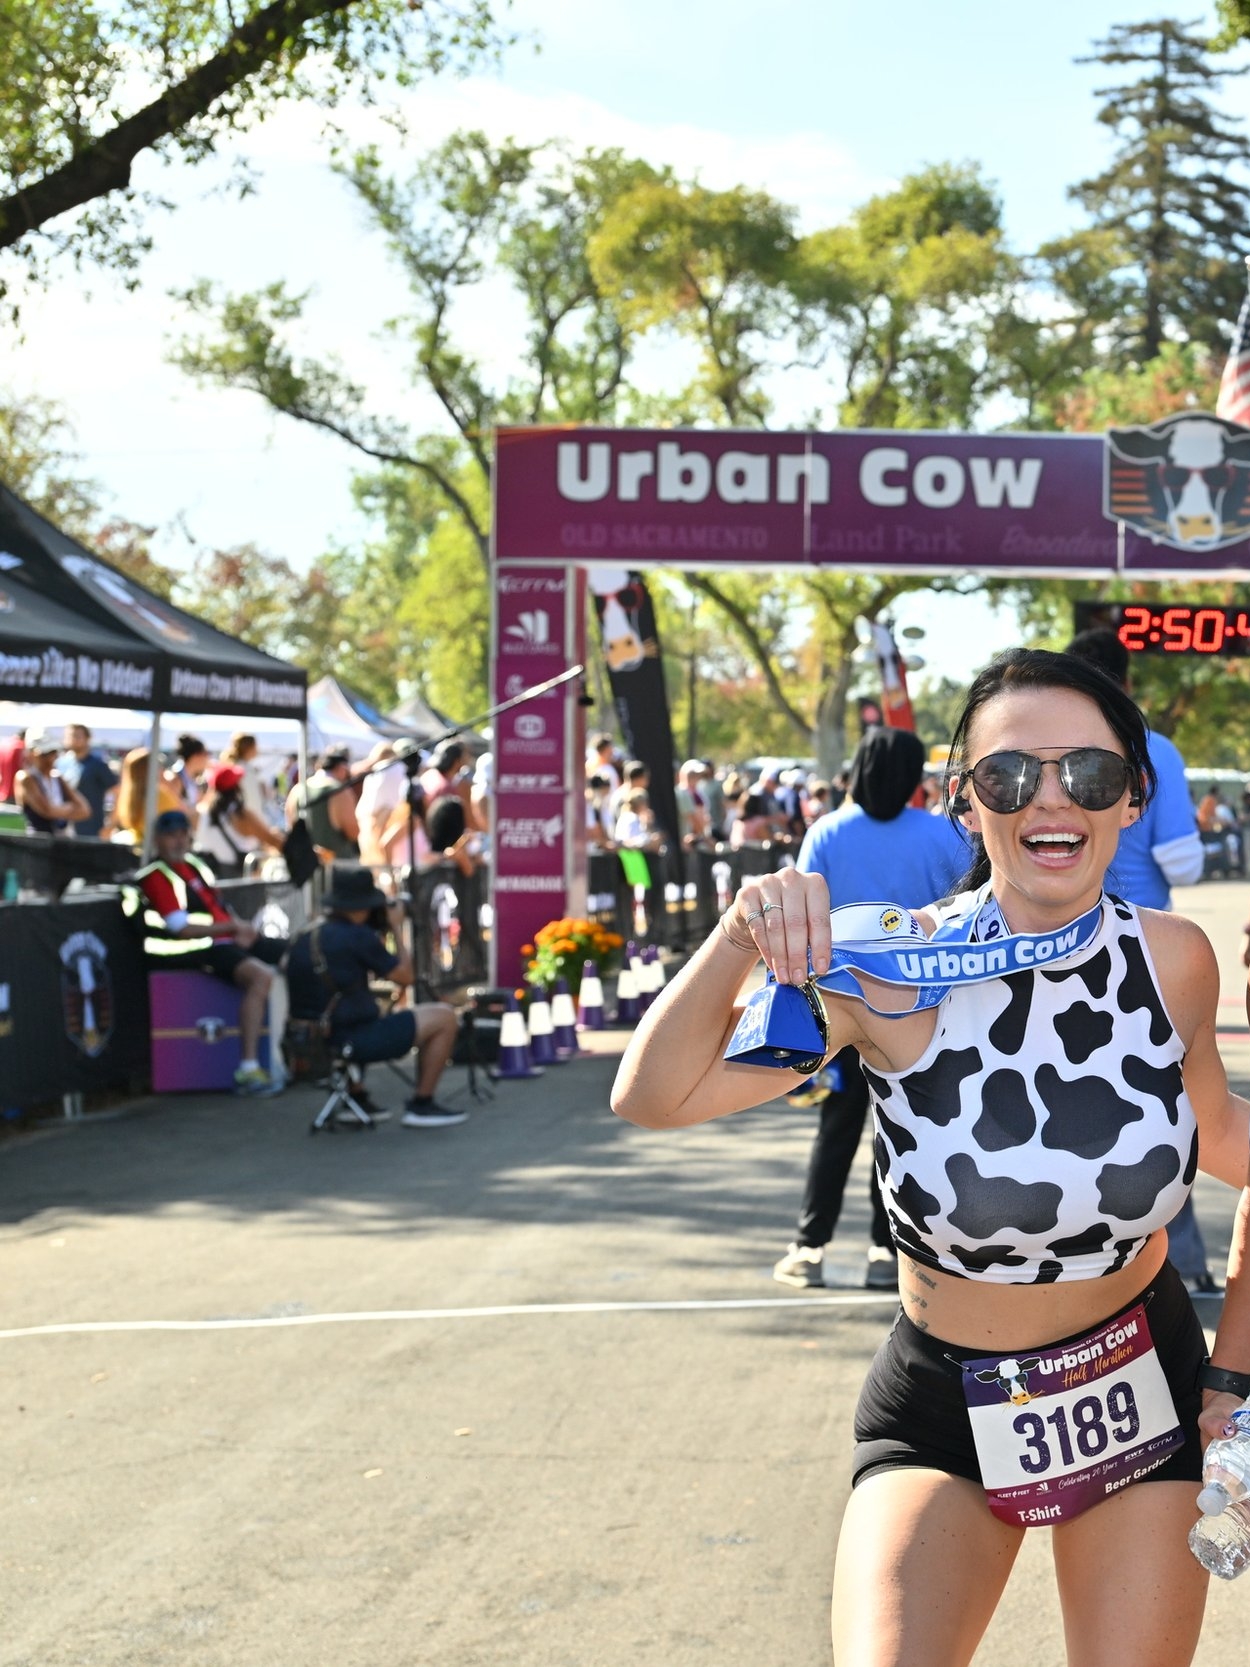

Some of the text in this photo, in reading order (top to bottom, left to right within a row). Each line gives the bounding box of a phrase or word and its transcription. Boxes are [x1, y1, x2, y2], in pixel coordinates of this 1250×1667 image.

[557, 442, 1042, 508] Urban Cow
[561, 524, 767, 550] OLD SACRAMENTO
[810, 522, 963, 554] Land Park
[896, 947, 1007, 980] Urban
[1014, 925, 1080, 964] Cow
[1039, 1320, 1138, 1375] Urban Cow
[1061, 1345, 1134, 1388] Half Marathon
[1012, 1381, 1141, 1474] 3189
[1058, 1470, 1091, 1490] Celebrating
[1105, 1454, 1173, 1494] Beer Garden
[1018, 1504, 1062, 1523] T-Shirt
